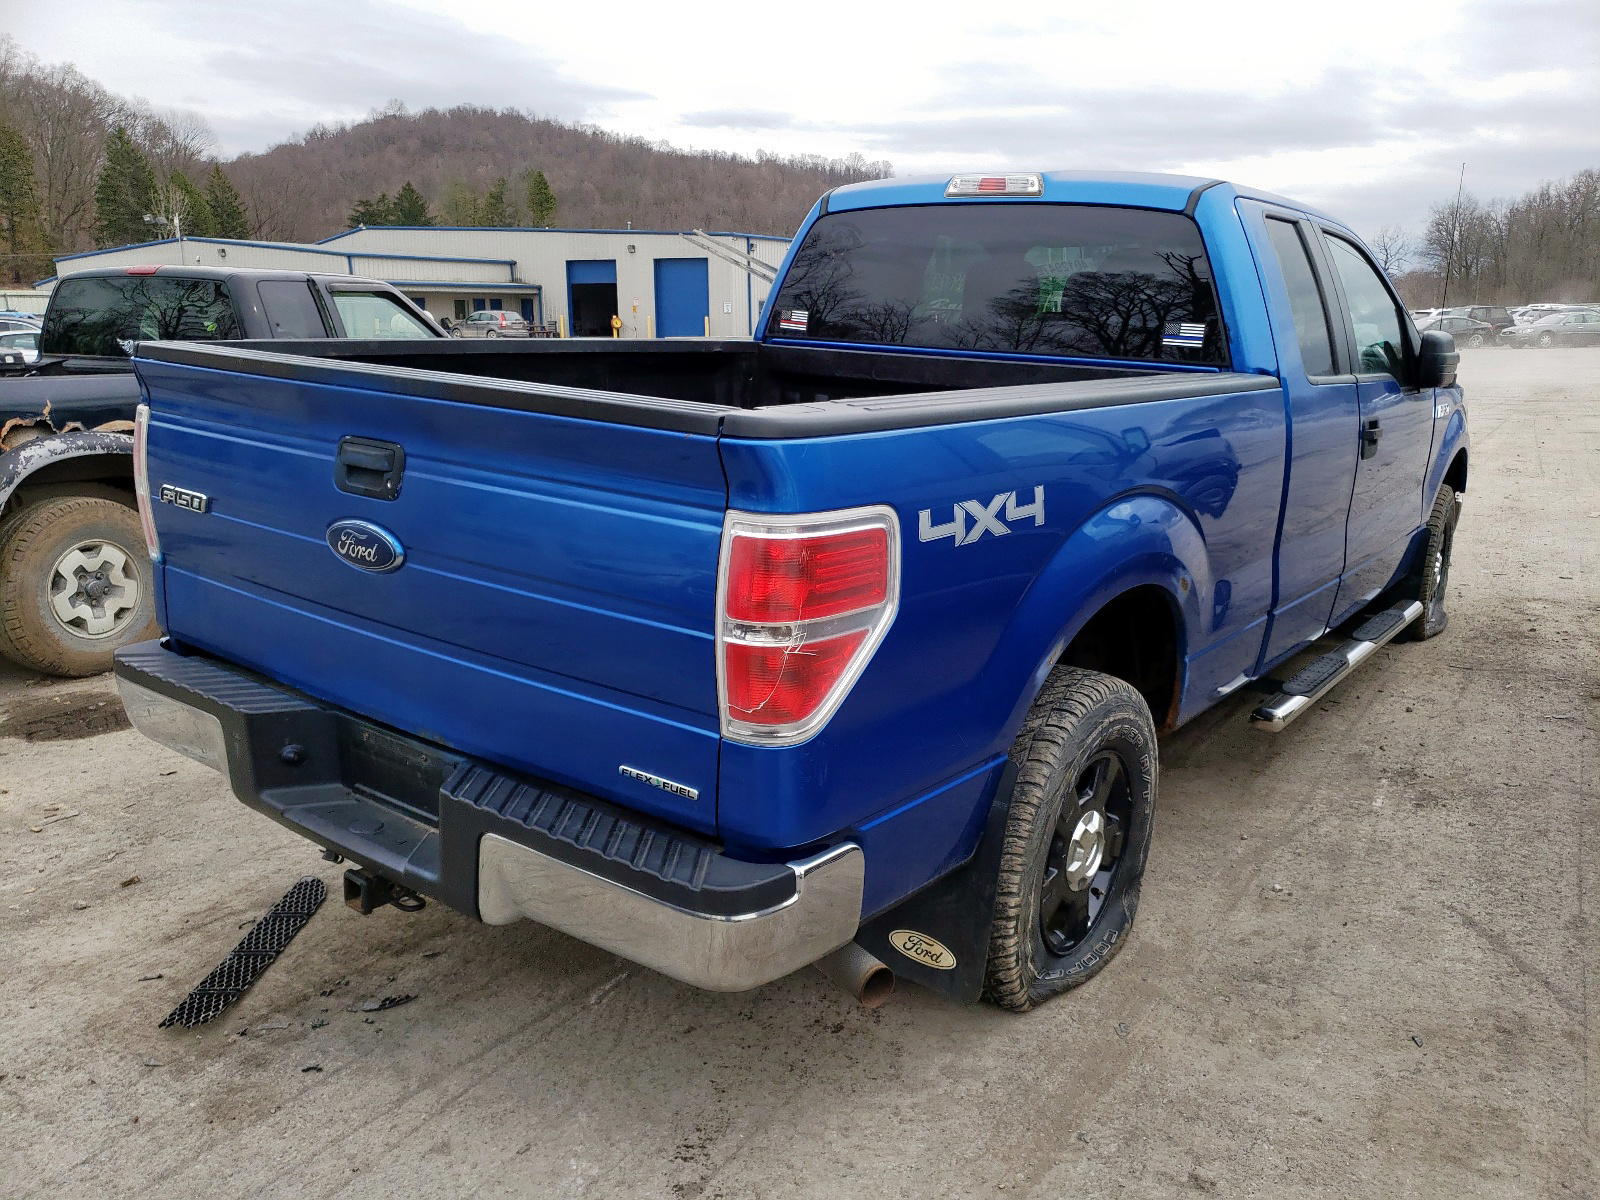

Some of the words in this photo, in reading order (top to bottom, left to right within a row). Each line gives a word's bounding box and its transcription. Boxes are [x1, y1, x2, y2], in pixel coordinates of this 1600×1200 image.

[337, 528, 378, 562] Ford
[621, 767, 652, 785] FLEX
[662, 780, 695, 800] FUEL
[902, 935, 943, 963] Ford
